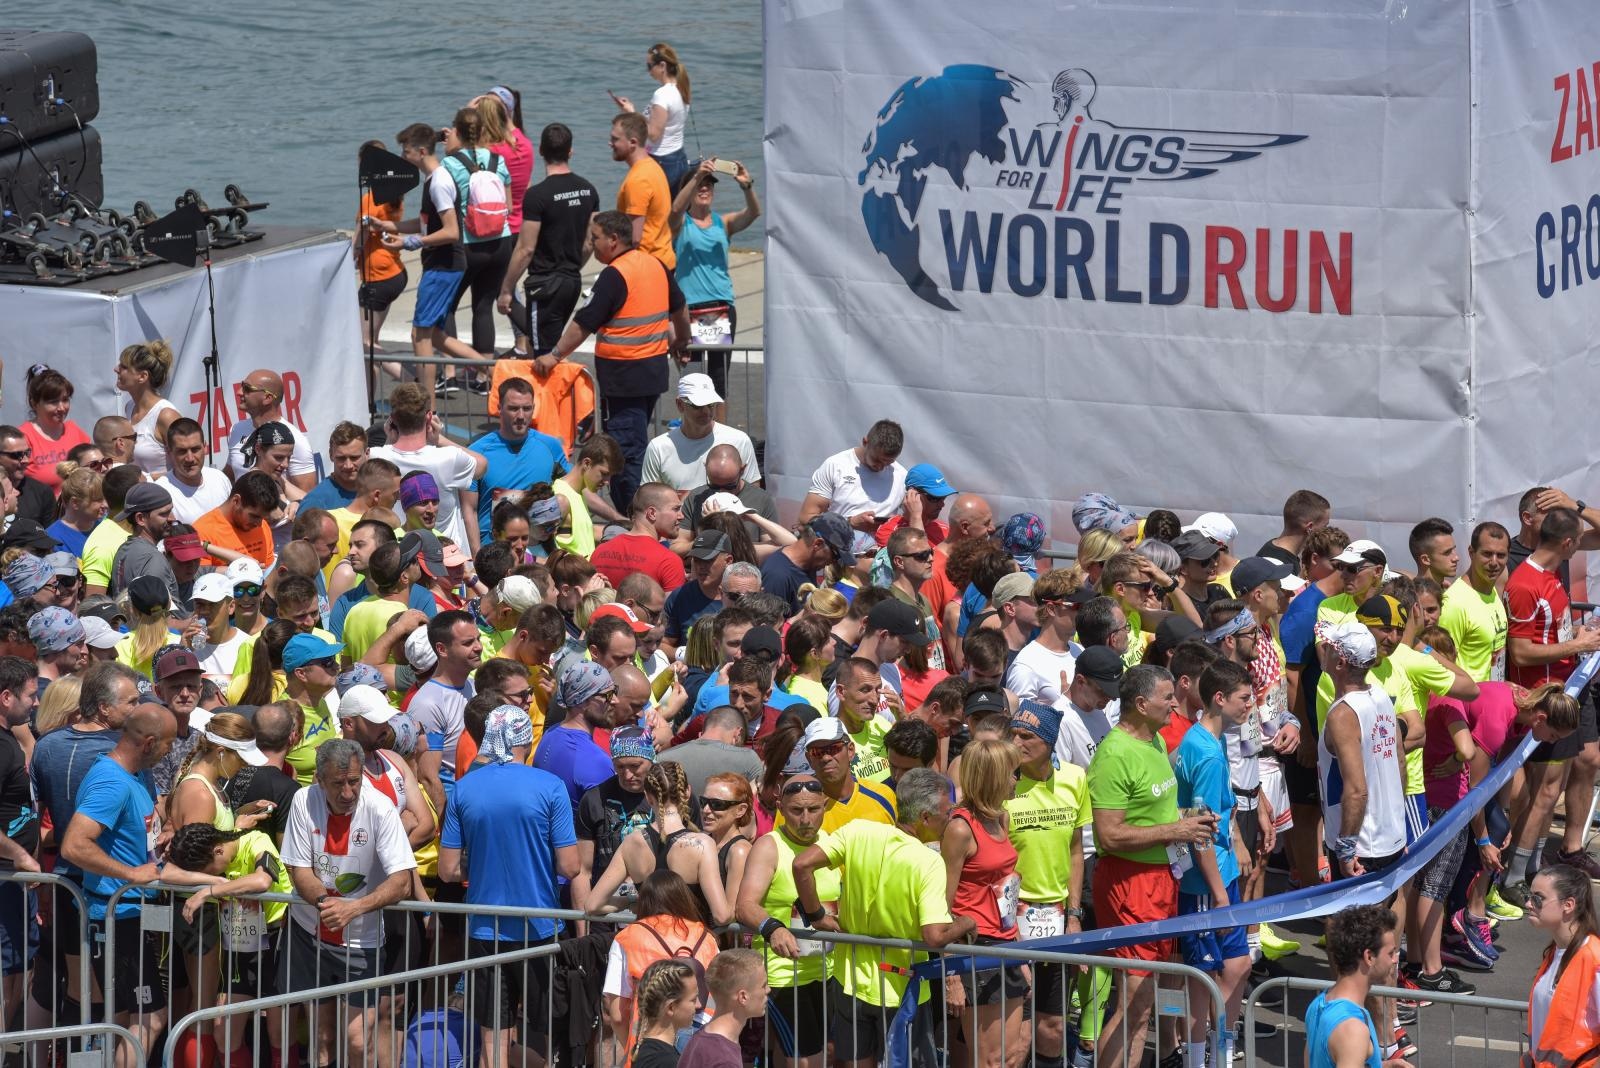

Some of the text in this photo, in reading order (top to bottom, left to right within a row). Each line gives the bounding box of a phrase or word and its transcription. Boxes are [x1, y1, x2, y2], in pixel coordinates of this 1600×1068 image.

[996, 170, 1033, 189] FOR
[938, 208, 1353, 316] WORLD RUN
[856, 761, 883, 779] WORLD
[1013, 816, 1037, 826] TREVISO
[1038, 814, 1067, 824] MARATHON
[1028, 925, 1057, 938] 7312
